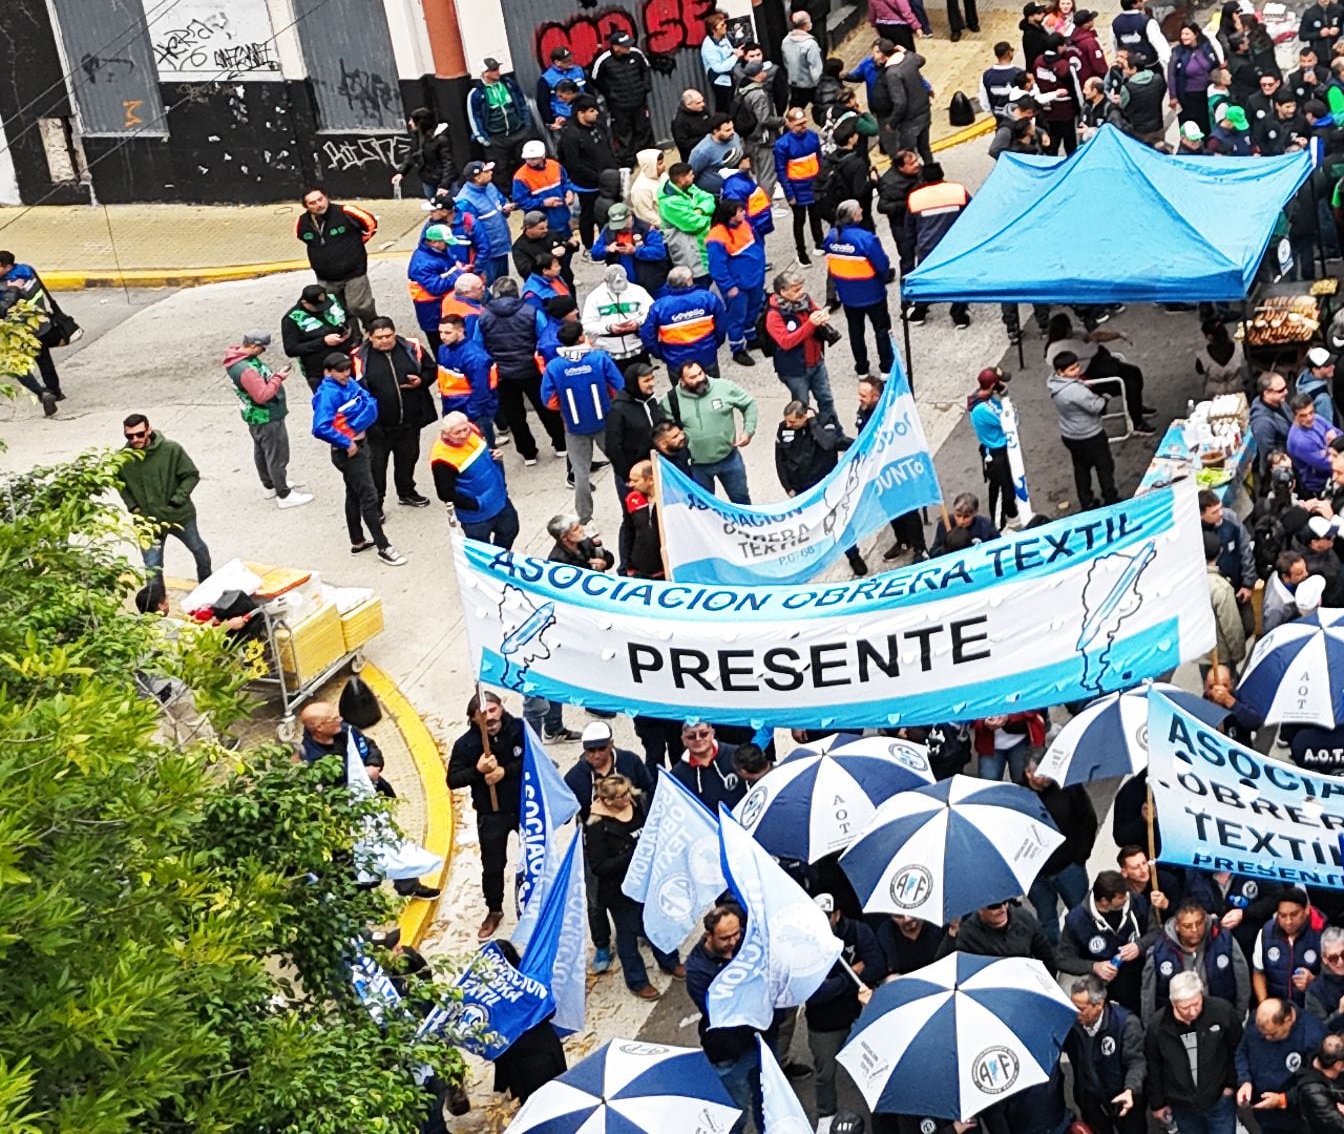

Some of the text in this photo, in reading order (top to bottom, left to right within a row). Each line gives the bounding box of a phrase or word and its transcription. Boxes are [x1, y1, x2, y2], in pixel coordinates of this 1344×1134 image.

[488, 510, 1144, 612] ASOCIACION OBRERA TEXTIL
[626, 615, 992, 694] PRESENTE
